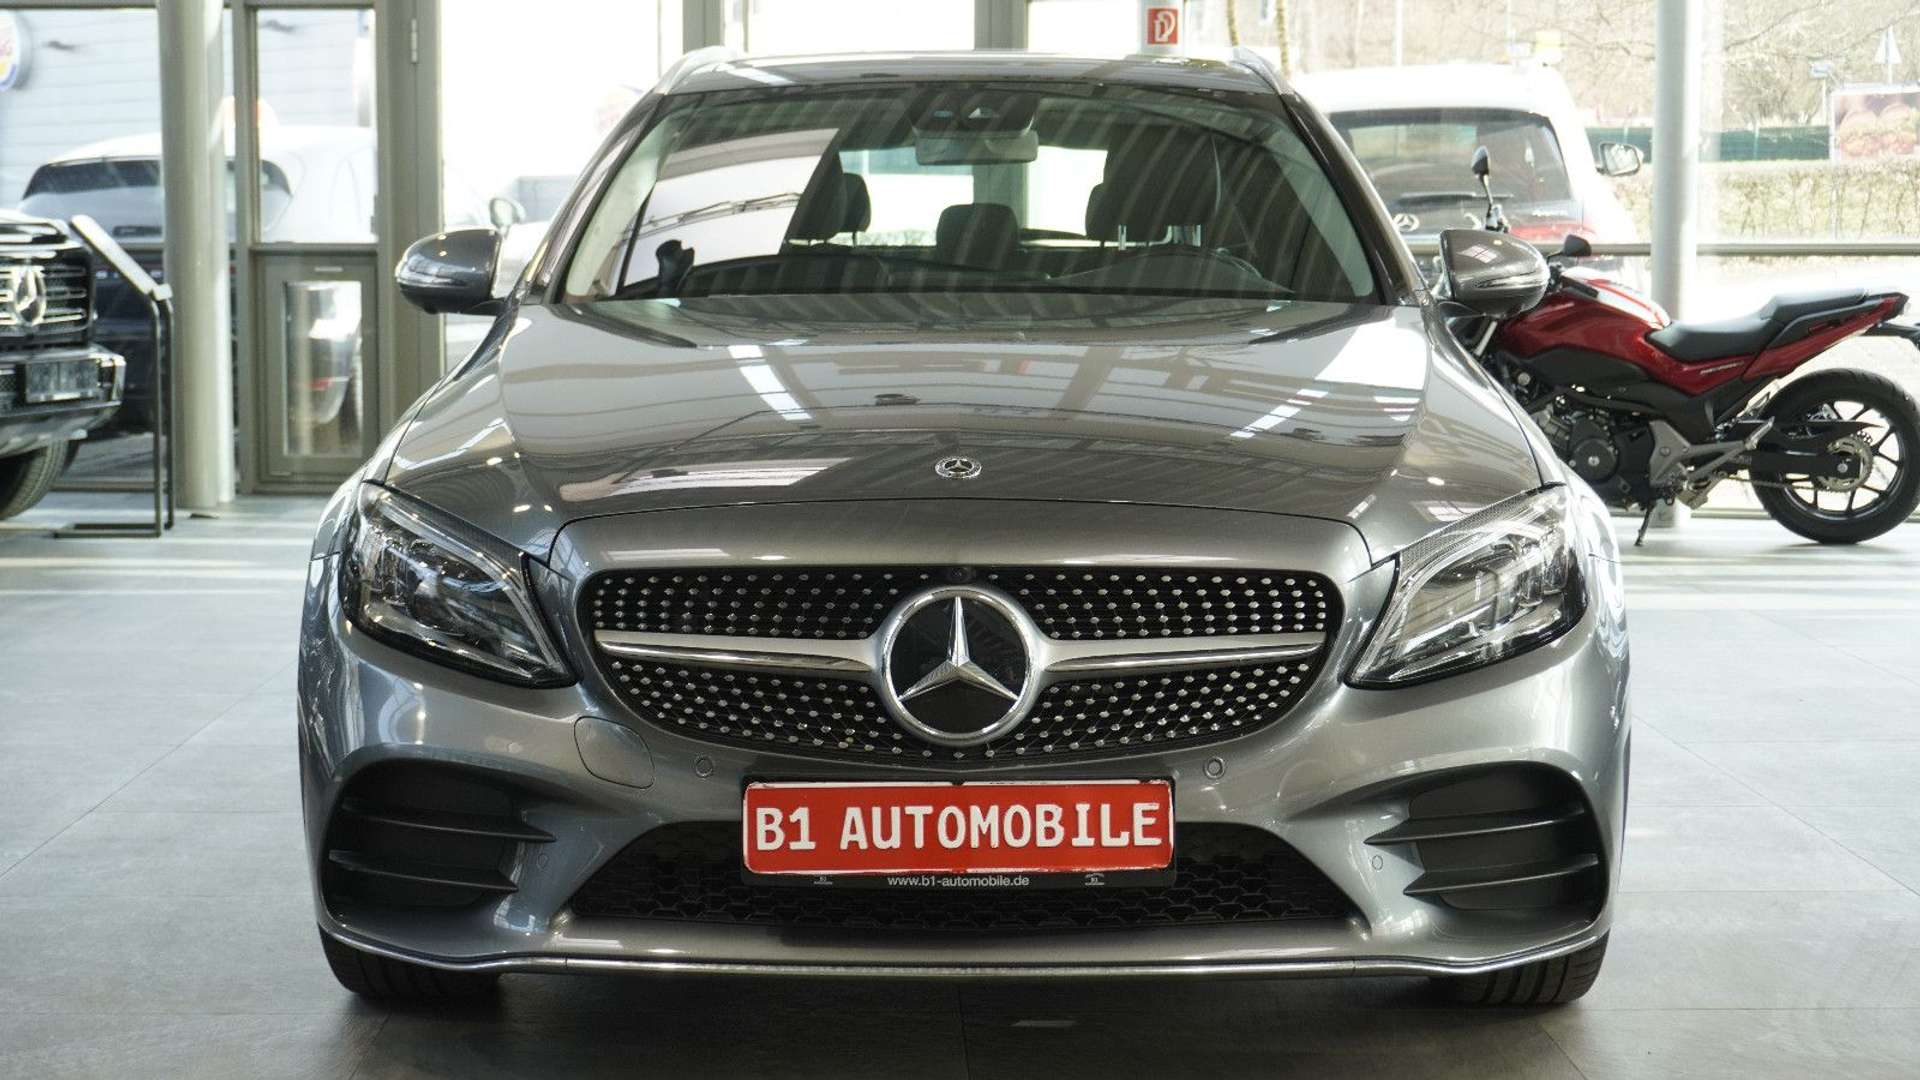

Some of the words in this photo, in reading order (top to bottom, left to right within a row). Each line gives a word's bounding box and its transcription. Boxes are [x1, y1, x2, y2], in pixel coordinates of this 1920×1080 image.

[756, 806, 816, 851] B1
[840, 803, 1162, 850] AUTOMOBILE
[887, 875, 1030, 887] www.b1-automobile.de
